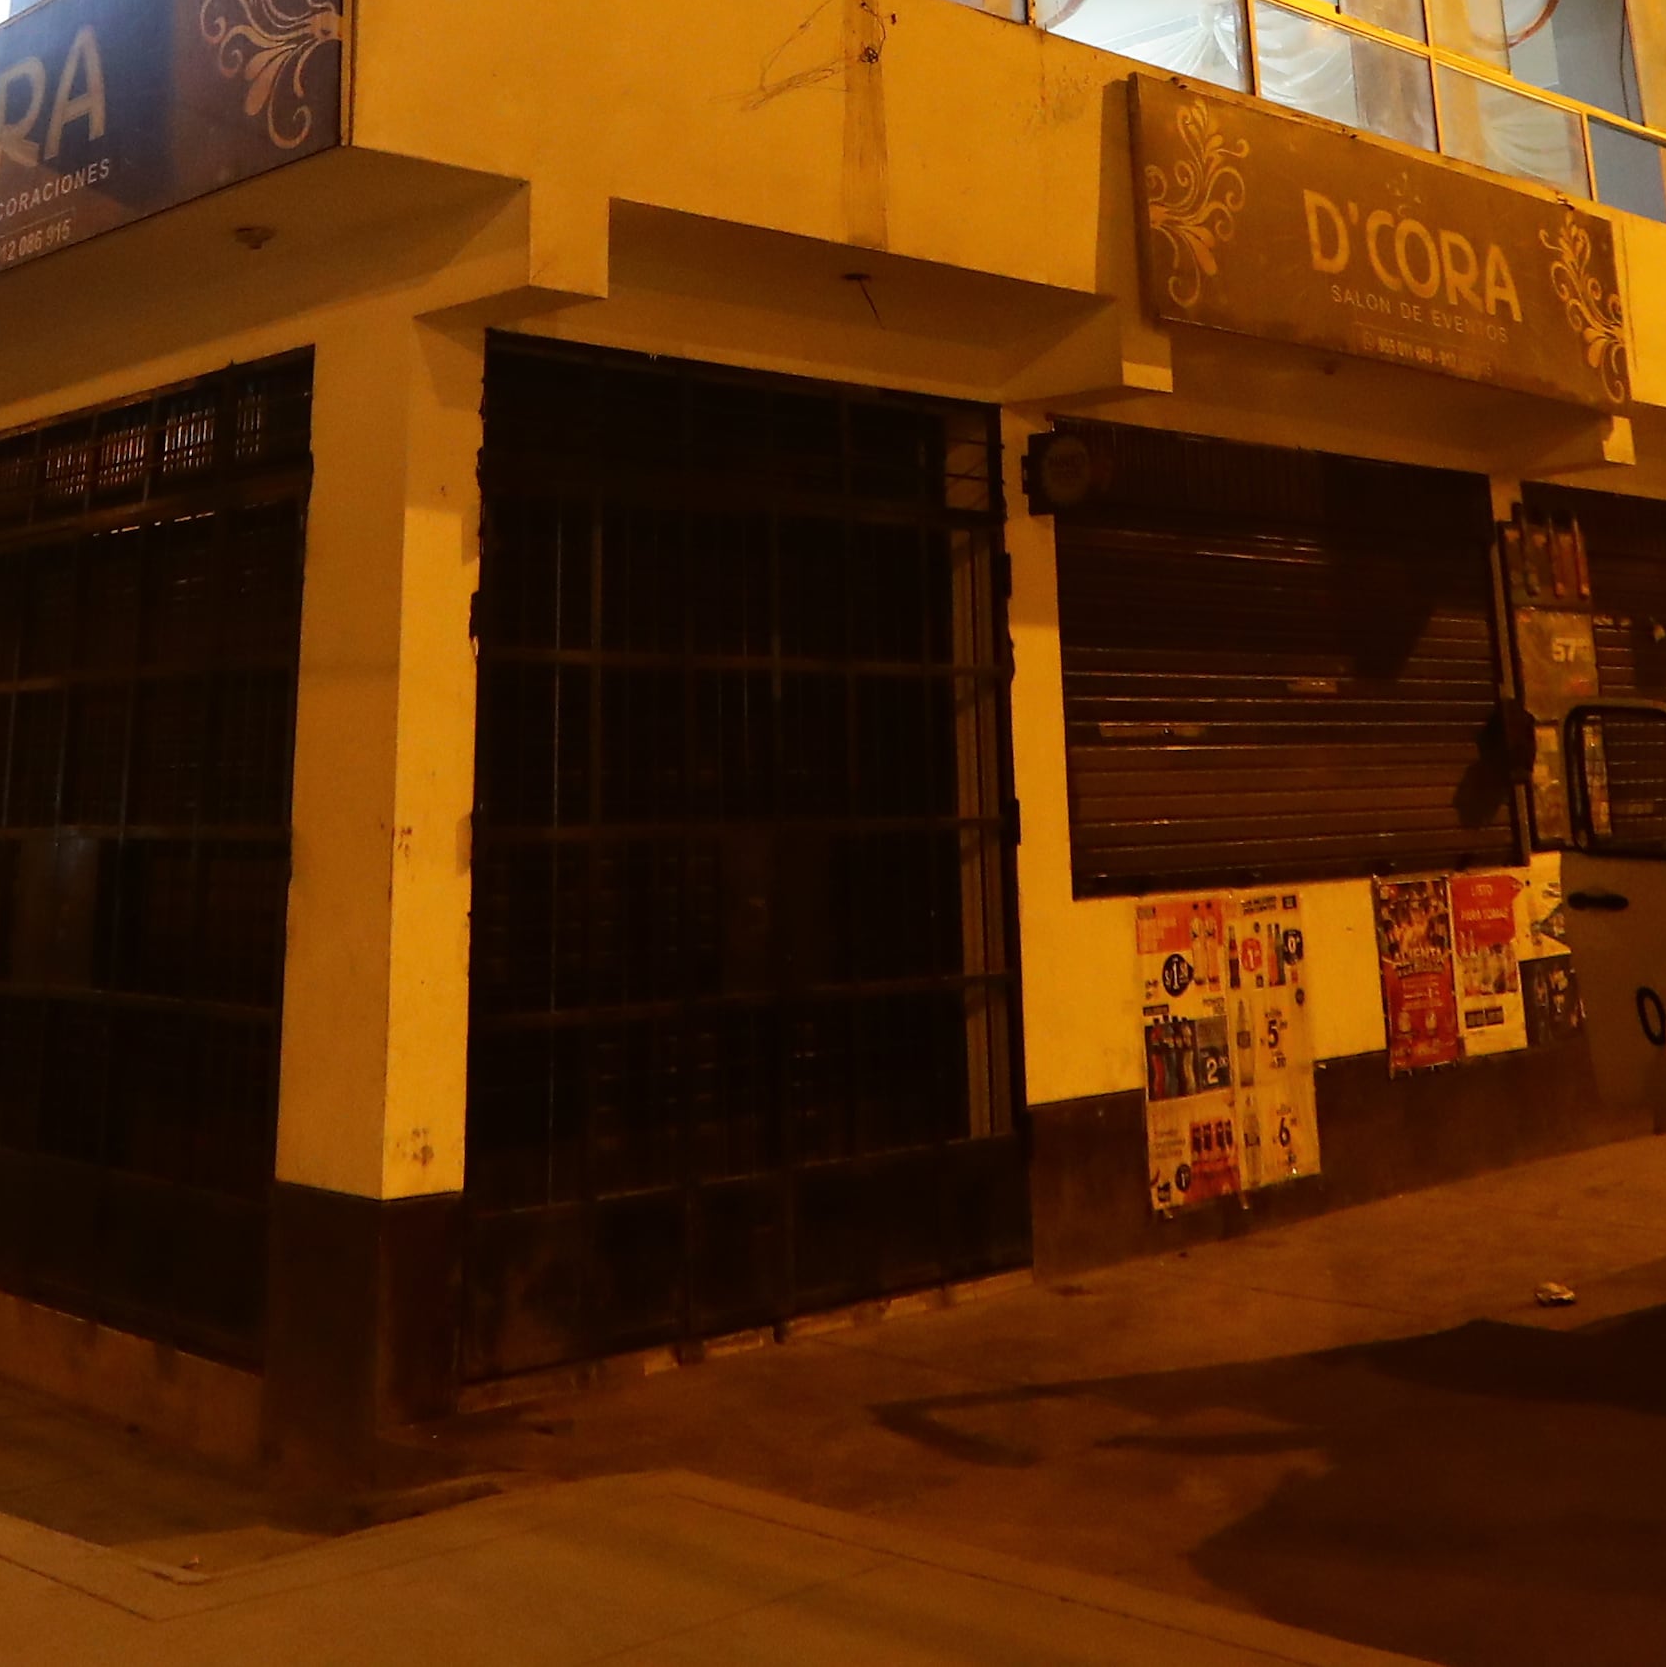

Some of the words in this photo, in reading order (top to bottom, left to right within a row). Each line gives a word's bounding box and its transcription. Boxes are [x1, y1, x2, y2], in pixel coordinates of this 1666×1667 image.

[1304, 189, 1522, 322] D'CORA
[1331, 284, 1392, 315] SALON
[1399, 301, 1423, 323] DE
